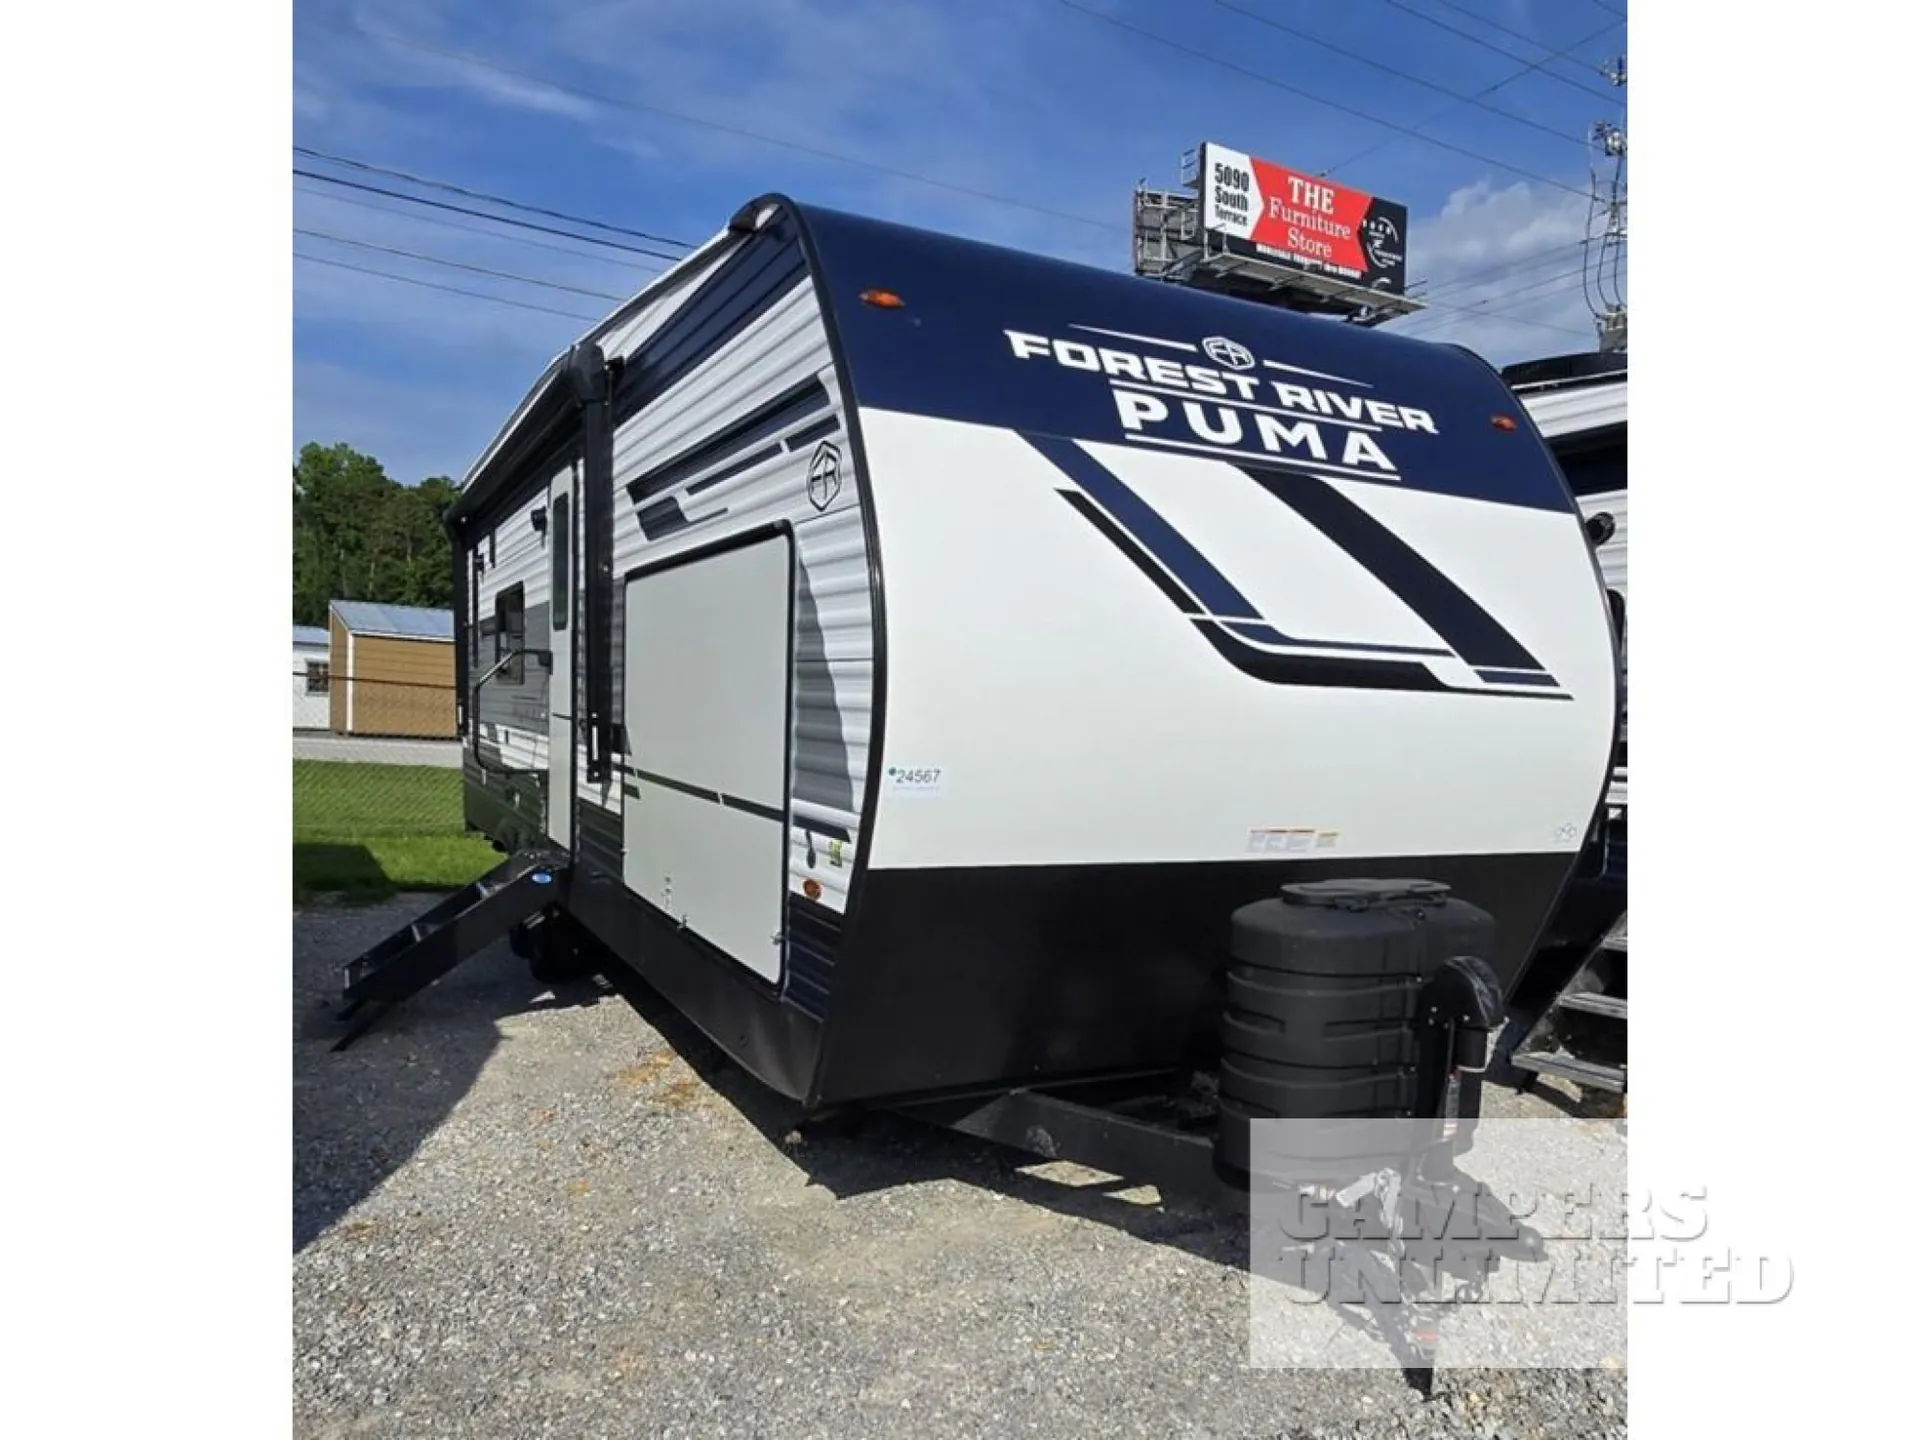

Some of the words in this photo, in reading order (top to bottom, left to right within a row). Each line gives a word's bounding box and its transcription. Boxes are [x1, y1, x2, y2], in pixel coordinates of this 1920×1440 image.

[1214, 162, 1249, 192] 5090
[1287, 175, 1334, 215] THE
[1214, 185, 1248, 212] South
[1269, 196, 1351, 240] Furniture
[1287, 226, 1332, 258] Store
[1003, 329, 1260, 400] FOREST
[1271, 380, 1439, 435] RIVER
[1113, 389, 1398, 472] PUMA
[896, 768, 941, 784] 24567
